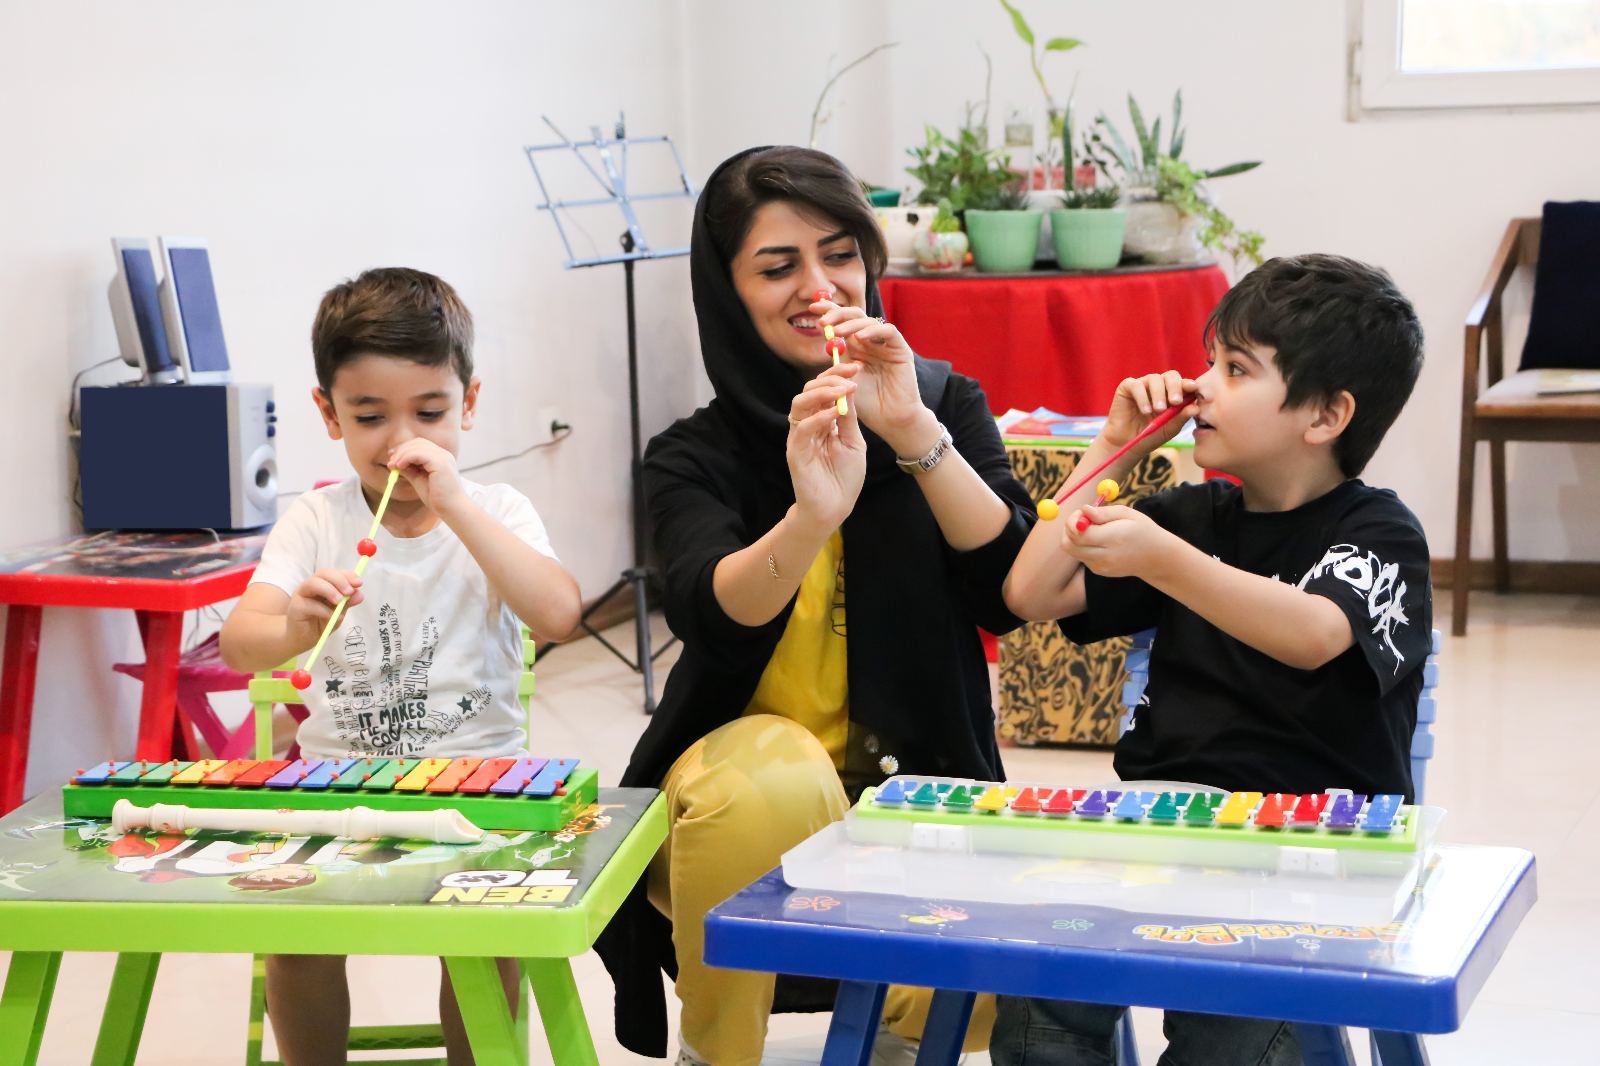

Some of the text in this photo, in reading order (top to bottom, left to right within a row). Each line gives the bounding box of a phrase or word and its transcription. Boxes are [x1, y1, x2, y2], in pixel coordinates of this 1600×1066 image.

[358, 712, 373, 729] IT
[380, 701, 426, 725] MAKES
[360, 726, 380, 741] ME
[440, 869, 579, 887] 10
[430, 885, 574, 903] BEN
